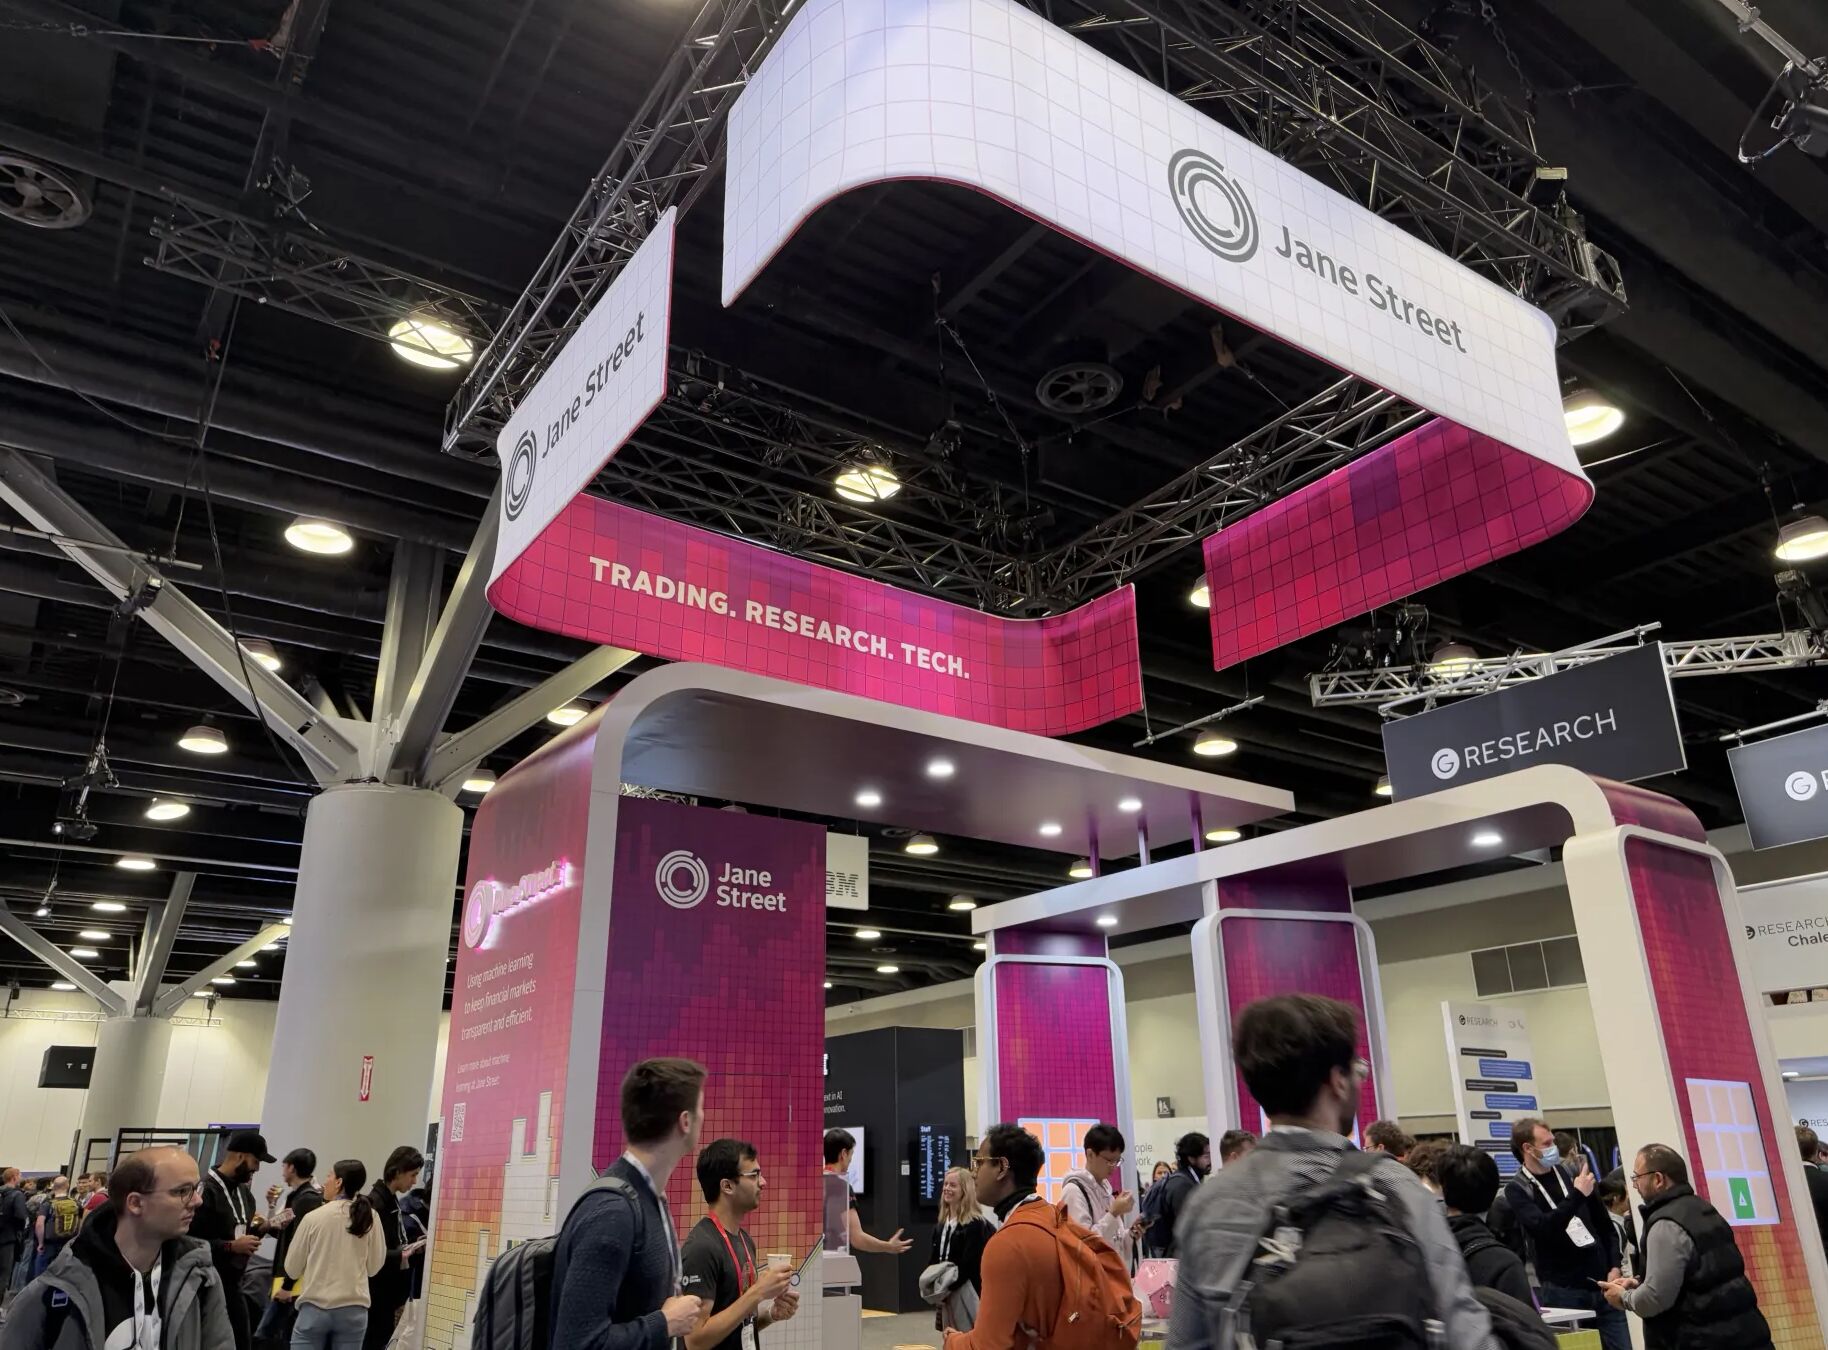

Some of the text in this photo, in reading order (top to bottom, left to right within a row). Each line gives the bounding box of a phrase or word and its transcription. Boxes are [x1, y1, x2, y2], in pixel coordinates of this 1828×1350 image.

[1275, 225, 1467, 353] Jane Street
[542, 311, 645, 458] Jane Street
[589, 556, 971, 679] TRADING. RESEARCH. TECH.
[1464, 708, 1617, 768] RESEARCH
[718, 862, 772, 888] Jane
[716, 885, 787, 912] Street
[467, 952, 534, 989] Using machine learning
[464, 979, 537, 1015] to keep financial markets
[461, 1006, 533, 1041] transparent and efficient
